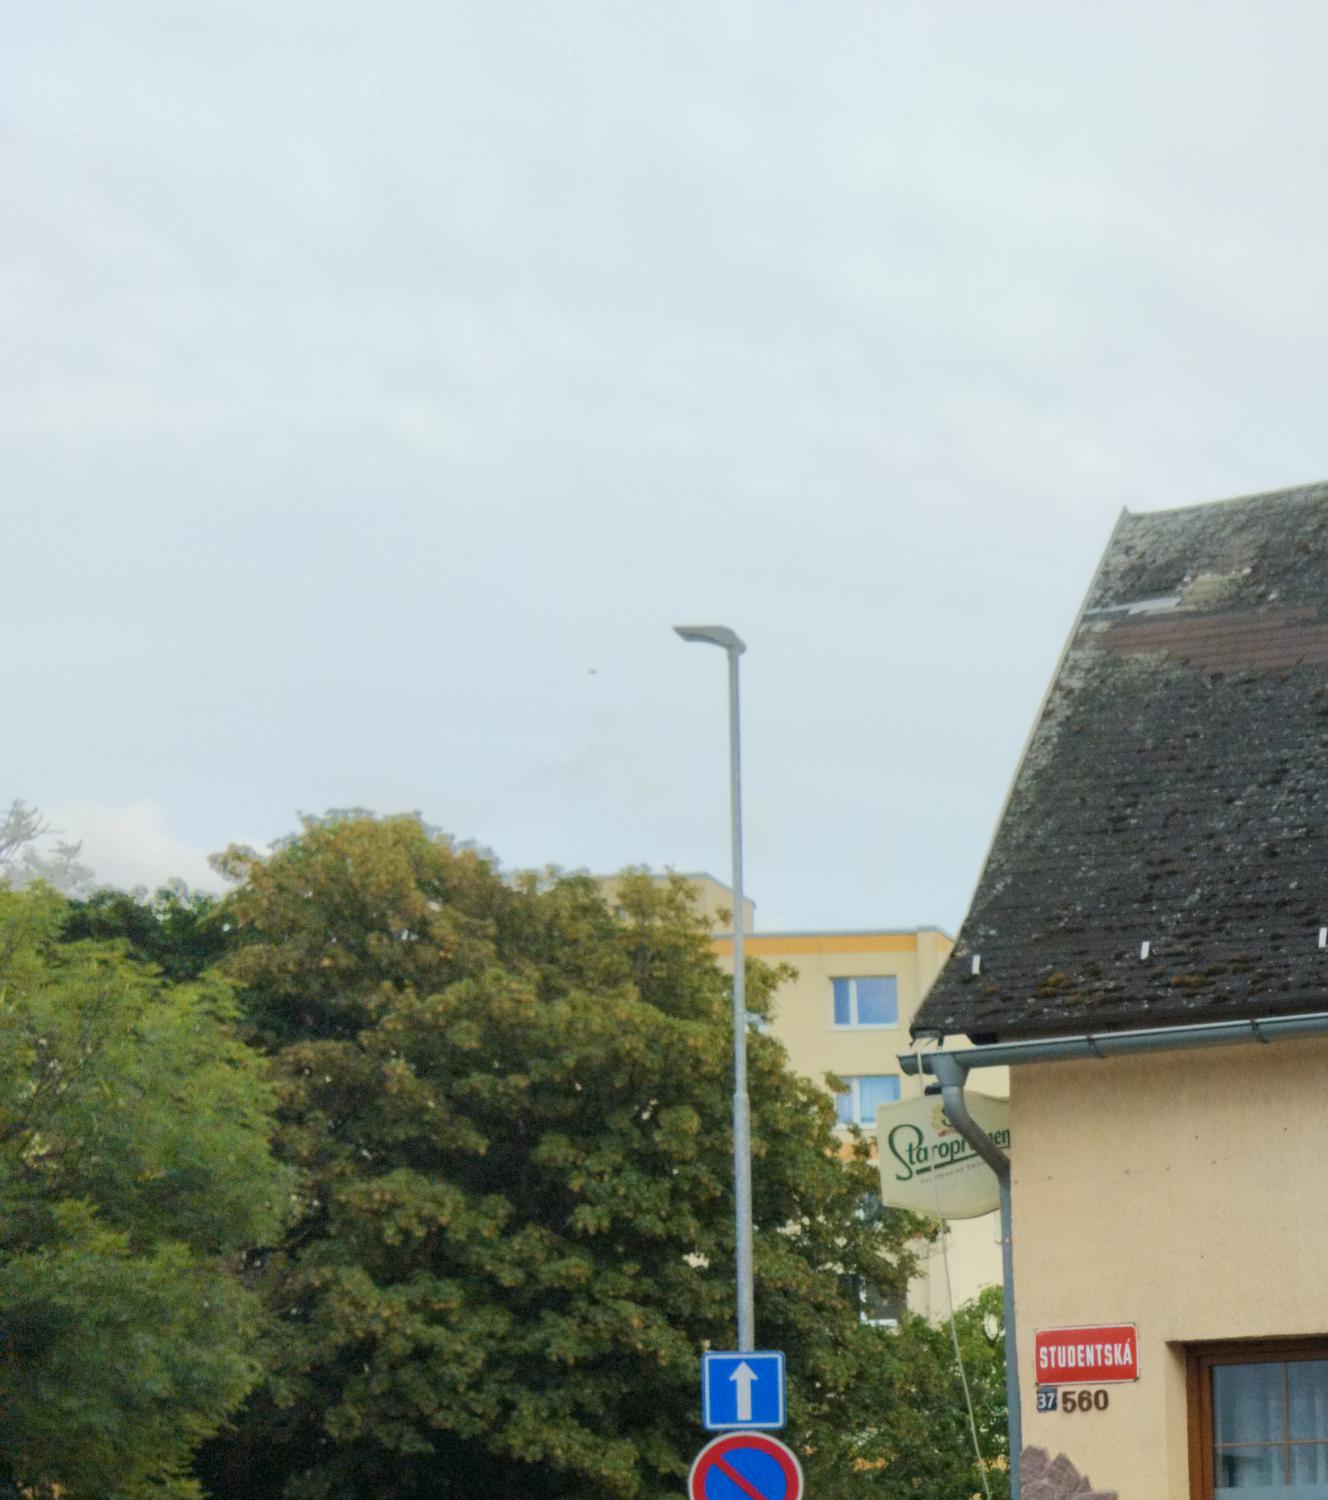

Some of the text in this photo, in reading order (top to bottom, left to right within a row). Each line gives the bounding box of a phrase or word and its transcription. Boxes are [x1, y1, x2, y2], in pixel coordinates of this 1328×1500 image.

[1040, 1337, 1133, 1369] STUDENTSKÁ
[1037, 1392, 1057, 1410] 37
[1061, 1388, 1109, 1413] 560
